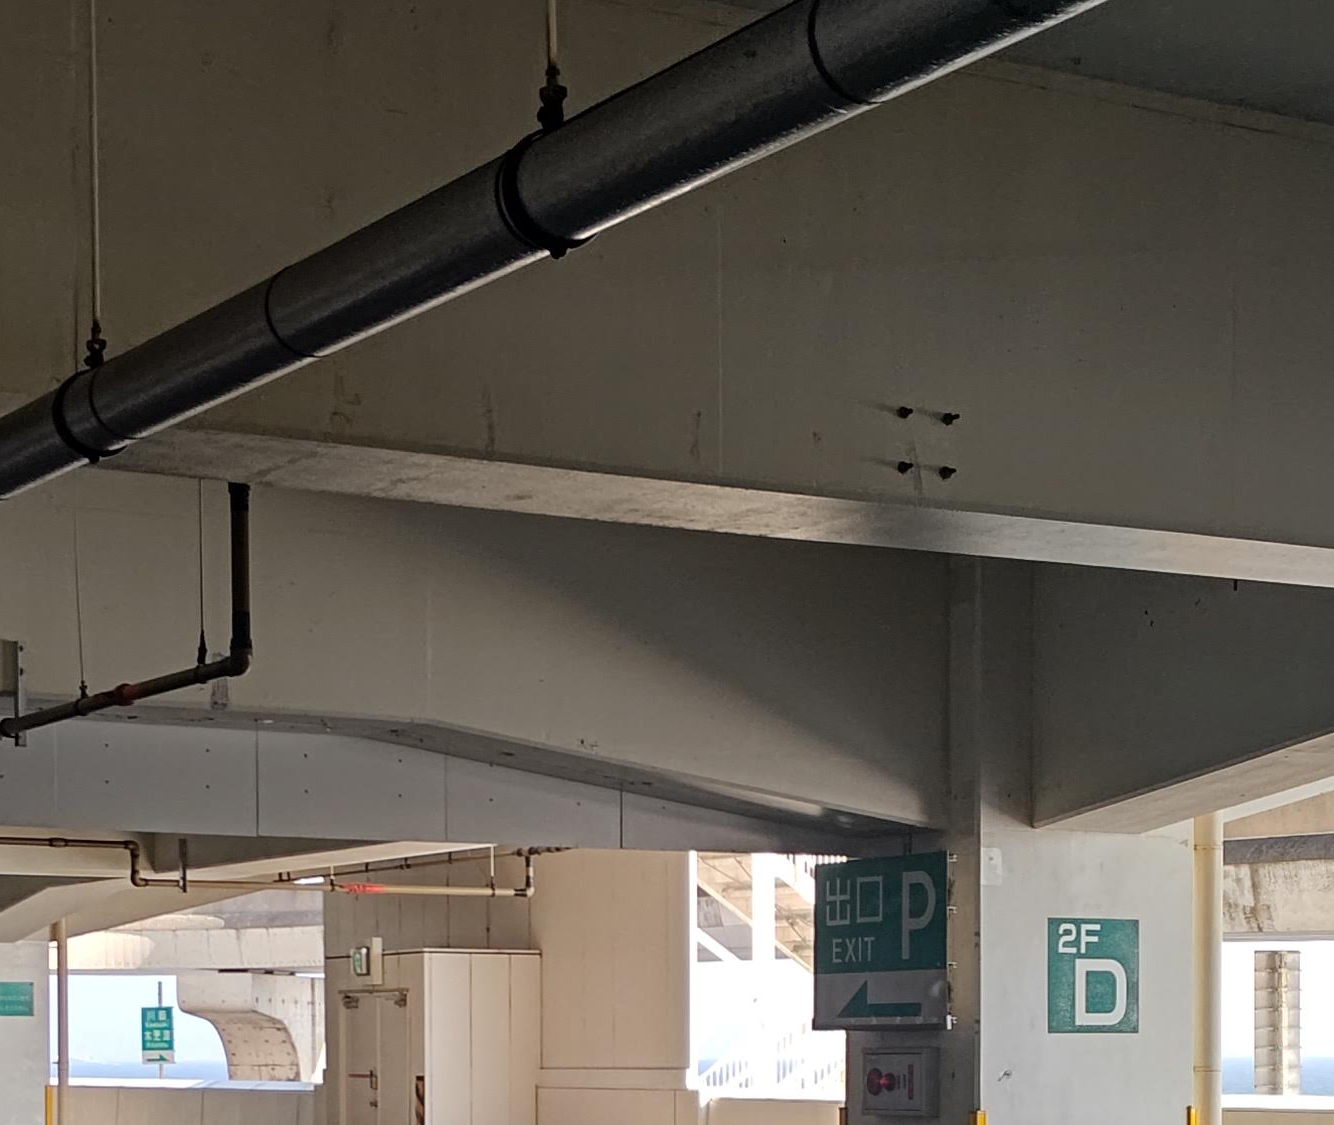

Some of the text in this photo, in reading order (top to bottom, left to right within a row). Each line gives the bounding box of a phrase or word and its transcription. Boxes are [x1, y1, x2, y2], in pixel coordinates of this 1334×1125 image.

[826, 876, 883, 926] 出口
[901, 870, 936, 960] P
[832, 937, 875, 963] EXIT
[1058, 923, 1101, 954] 2F
[1075, 959, 1127, 1026] D
